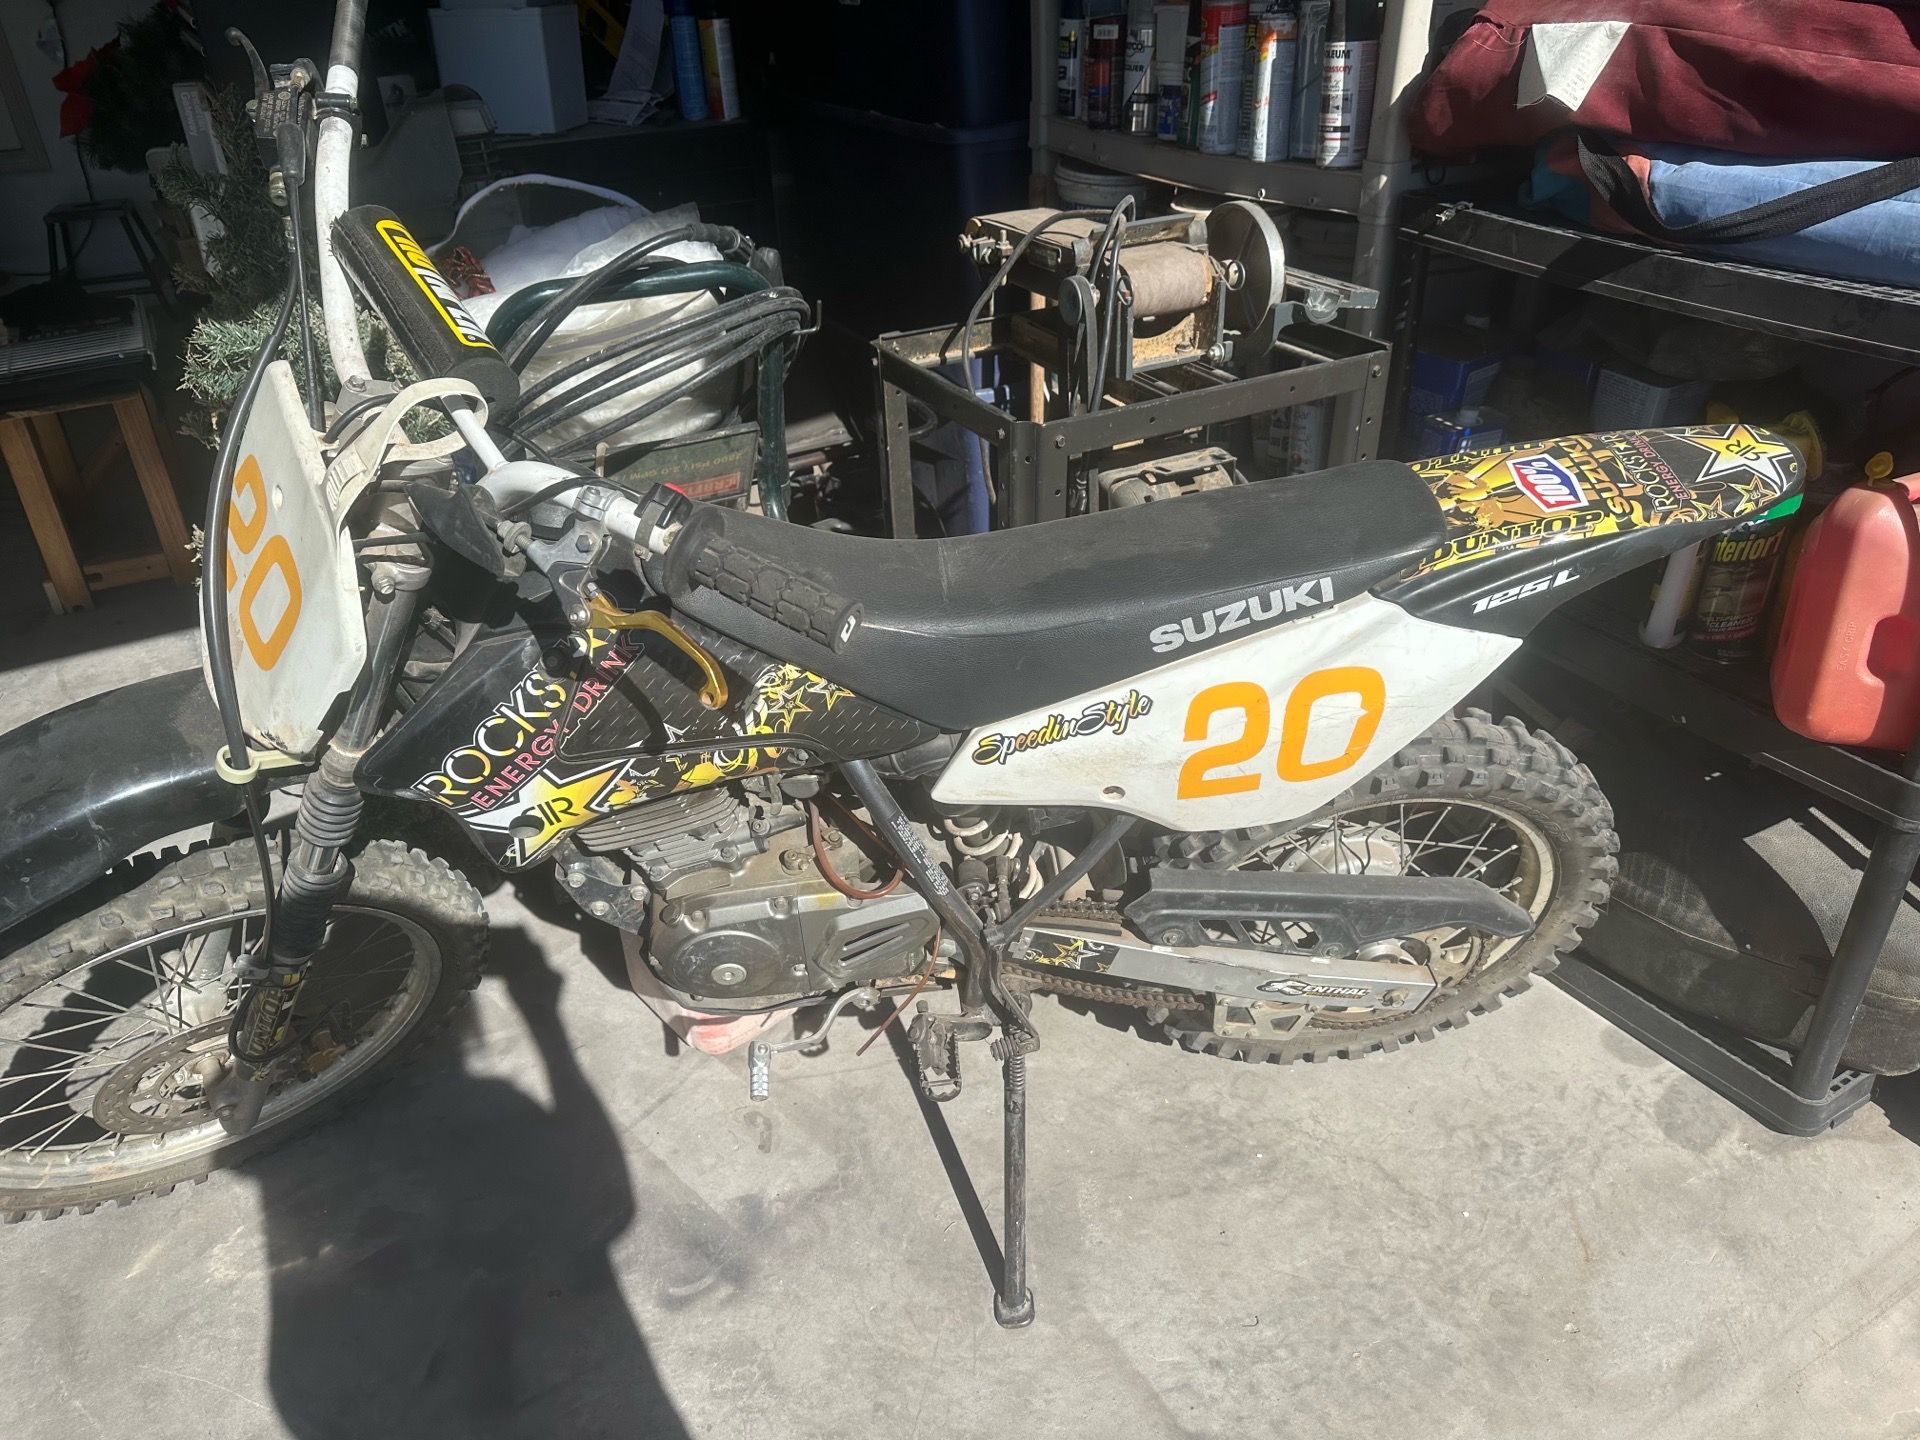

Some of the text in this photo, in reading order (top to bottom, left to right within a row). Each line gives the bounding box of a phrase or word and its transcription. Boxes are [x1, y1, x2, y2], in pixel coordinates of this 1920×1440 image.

[1516, 459, 1580, 509] 100%
[1560, 436, 1634, 516] SUZUKI
[1650, 460, 1690, 501] ENERGY
[1420, 509, 1606, 568] DUNLOP
[1149, 576, 1335, 653] SUZUKI
[470, 717, 570, 811] ENERGY
[971, 688, 1153, 765] SpeedinStyle
[1176, 665, 1387, 800] 20
